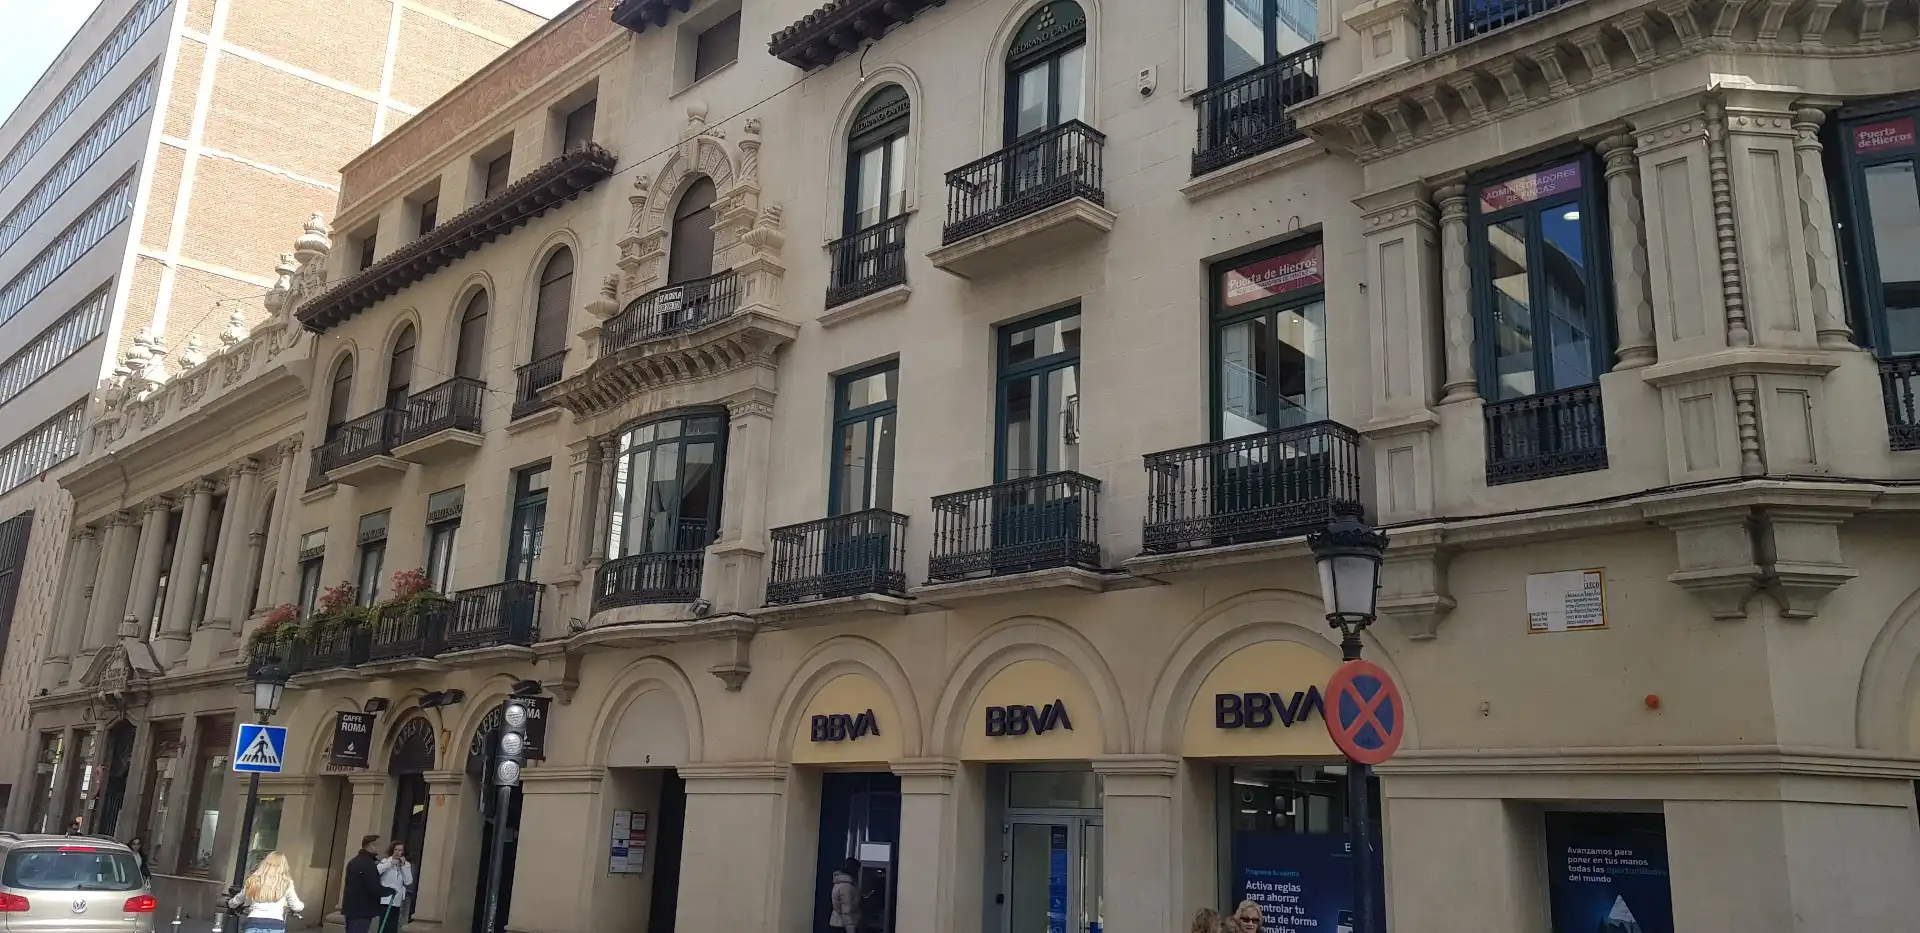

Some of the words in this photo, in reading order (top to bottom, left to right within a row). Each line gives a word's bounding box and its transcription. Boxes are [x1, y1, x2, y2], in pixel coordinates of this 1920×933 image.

[1009, 33, 1049, 56] MEDRANO
[1050, 14, 1085, 38] CANTOS
[1858, 128, 1896, 139] Puerta
[1486, 168, 1576, 200] ADMINISTRADORES
[1506, 194, 1520, 205] DE
[1521, 183, 1556, 199] FINCAS
[1229, 272, 1262, 289] Puerta
[1264, 268, 1277, 279] de
[1279, 258, 1317, 275] Hierros
[1216, 685, 1326, 728] BBVA
[343, 714, 362, 722] CAFFE
[985, 699, 1073, 736] BBVA
[341, 722, 366, 733] ROMA
[811, 709, 881, 742] BBVA
[1568, 847, 1612, 855] Avanzamos
[1615, 849, 1633, 857] para
[1245, 868, 1271, 876] Programa
[1568, 865, 1591, 873] todas
[1583, 875, 1612, 883] mundo
[1246, 880, 1272, 891] Activa
[1274, 882, 1301, 893] reglas
[1246, 893, 1265, 901] para
[1267, 892, 1299, 903] ahorrar
[1259, 903, 1293, 914] ontrolar
[1295, 905, 1304, 914] tu
[1278, 915, 1289, 924] de
[1290, 915, 1317, 926] forma
